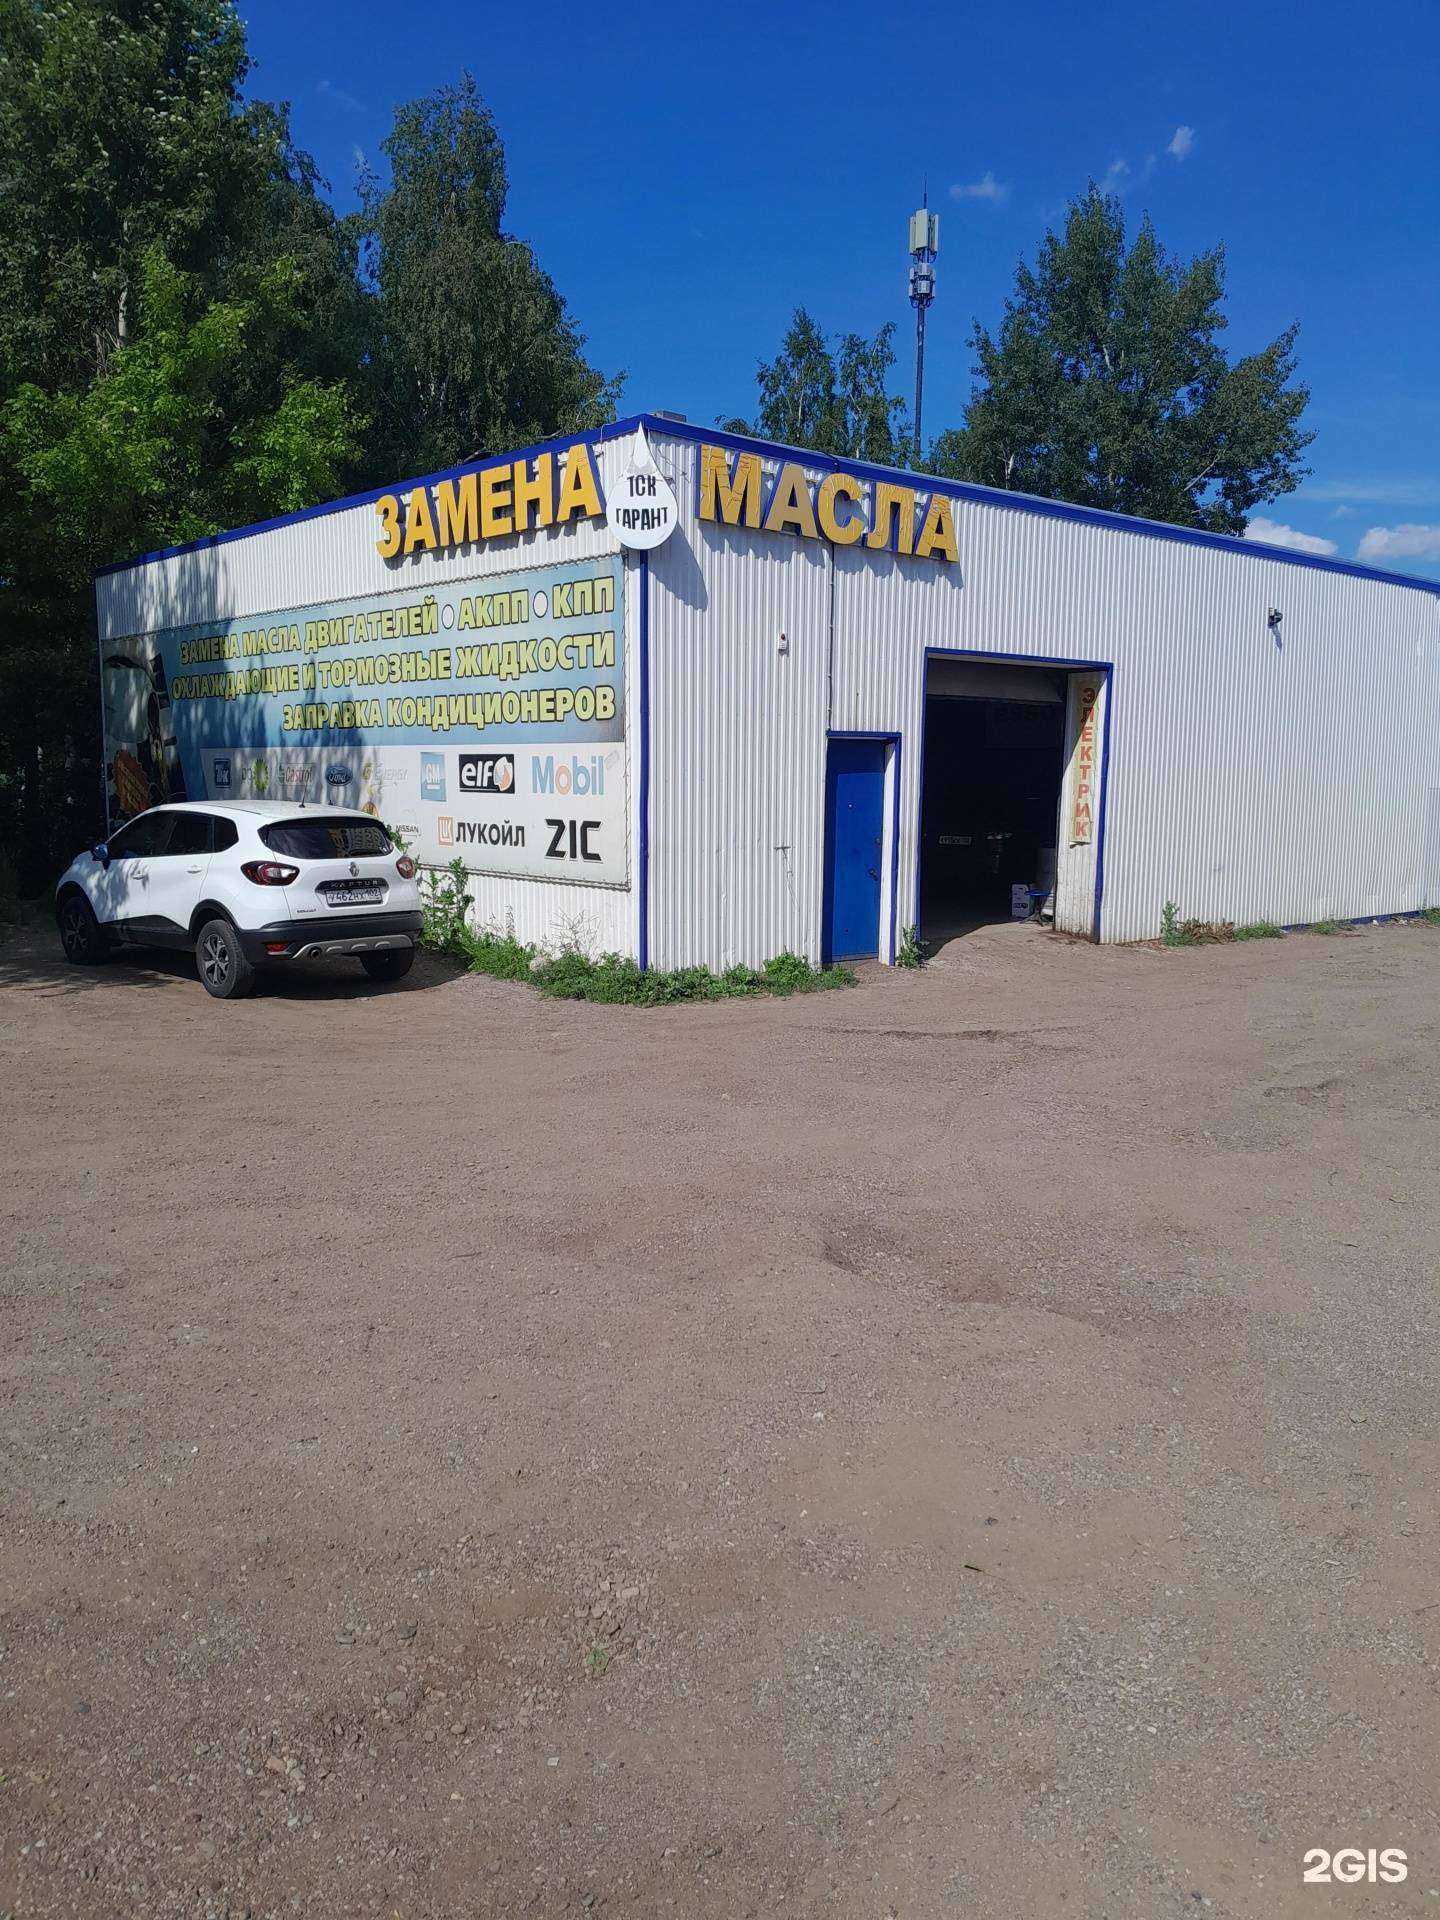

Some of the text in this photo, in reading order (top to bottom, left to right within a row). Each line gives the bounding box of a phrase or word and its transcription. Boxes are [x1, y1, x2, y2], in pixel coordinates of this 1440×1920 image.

[375, 443, 603, 559] ЗАМЕНА
[626, 474, 657, 497] ТСК
[697, 443, 959, 563] МАСЛА
[615, 507, 668, 530] ГАРАНТ
[180, 576, 615, 665] ЗАМЕНА МАСЛА ДВИГАТЕЛЕЙ АКПП КПП
[171, 631, 616, 701] ОХЛАЖДАЮЩИЕ И ТОРМОЗНЫЕ ЖИДКОСТИ
[282, 685, 616, 732] ЗАПРАВКА КОНДИЦИОНЕРОВ
[425, 763, 441, 784] GM
[461, 761, 494, 788] elf
[530, 755, 605, 796] Mobil
[1070, 687, 1097, 837] ЭЛЕКТРИК
[456, 820, 526, 847] ЛУКОЙЛ
[544, 818, 603, 863] ZIC
